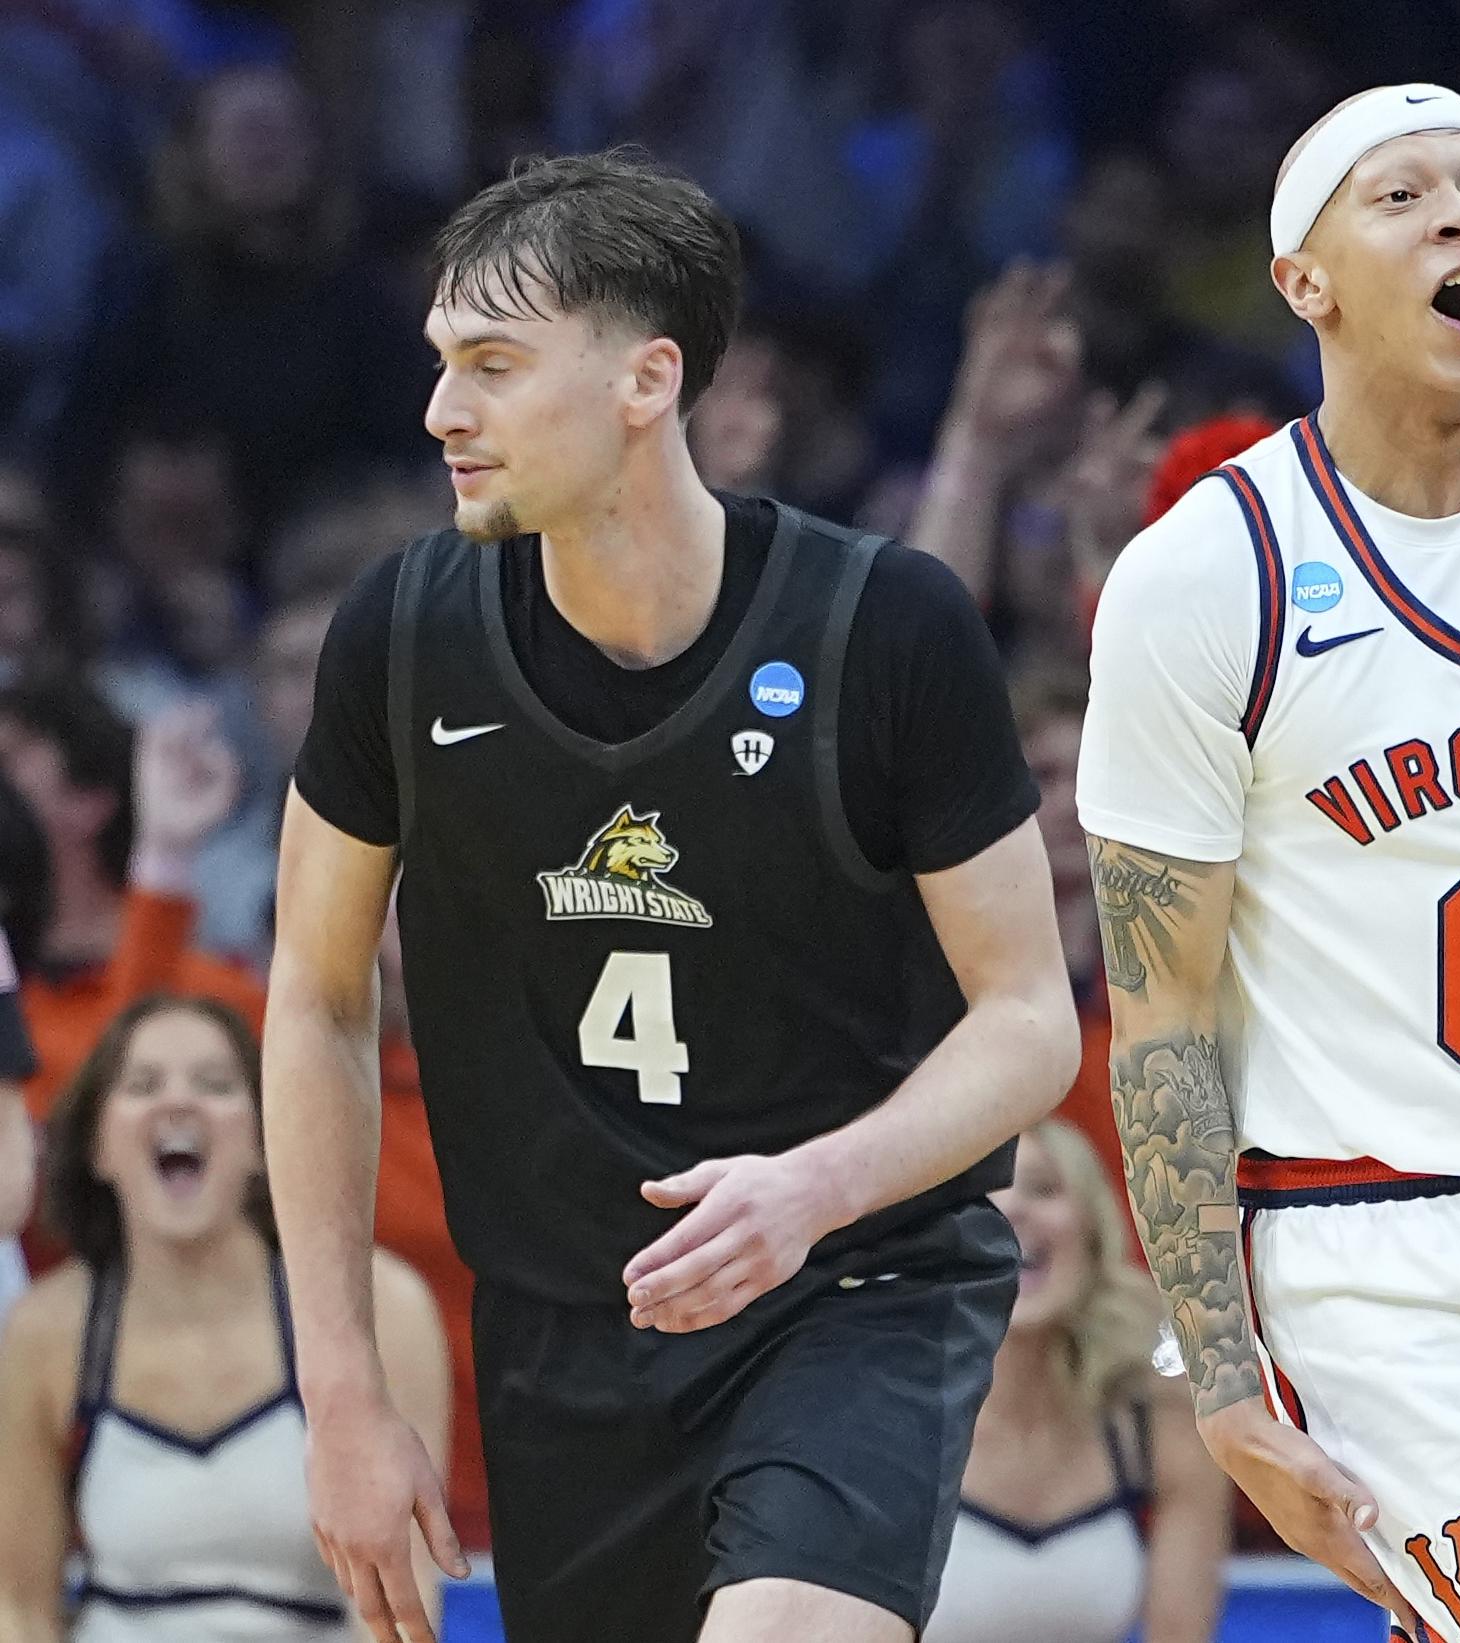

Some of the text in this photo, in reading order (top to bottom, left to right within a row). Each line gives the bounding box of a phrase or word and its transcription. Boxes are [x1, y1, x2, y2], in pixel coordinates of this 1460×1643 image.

[1295, 582, 1340, 601] NCAA
[756, 686, 800, 705] NCAA
[545, 876, 709, 923] WRIGHT STATE
[578, 951, 690, 1105] 4
